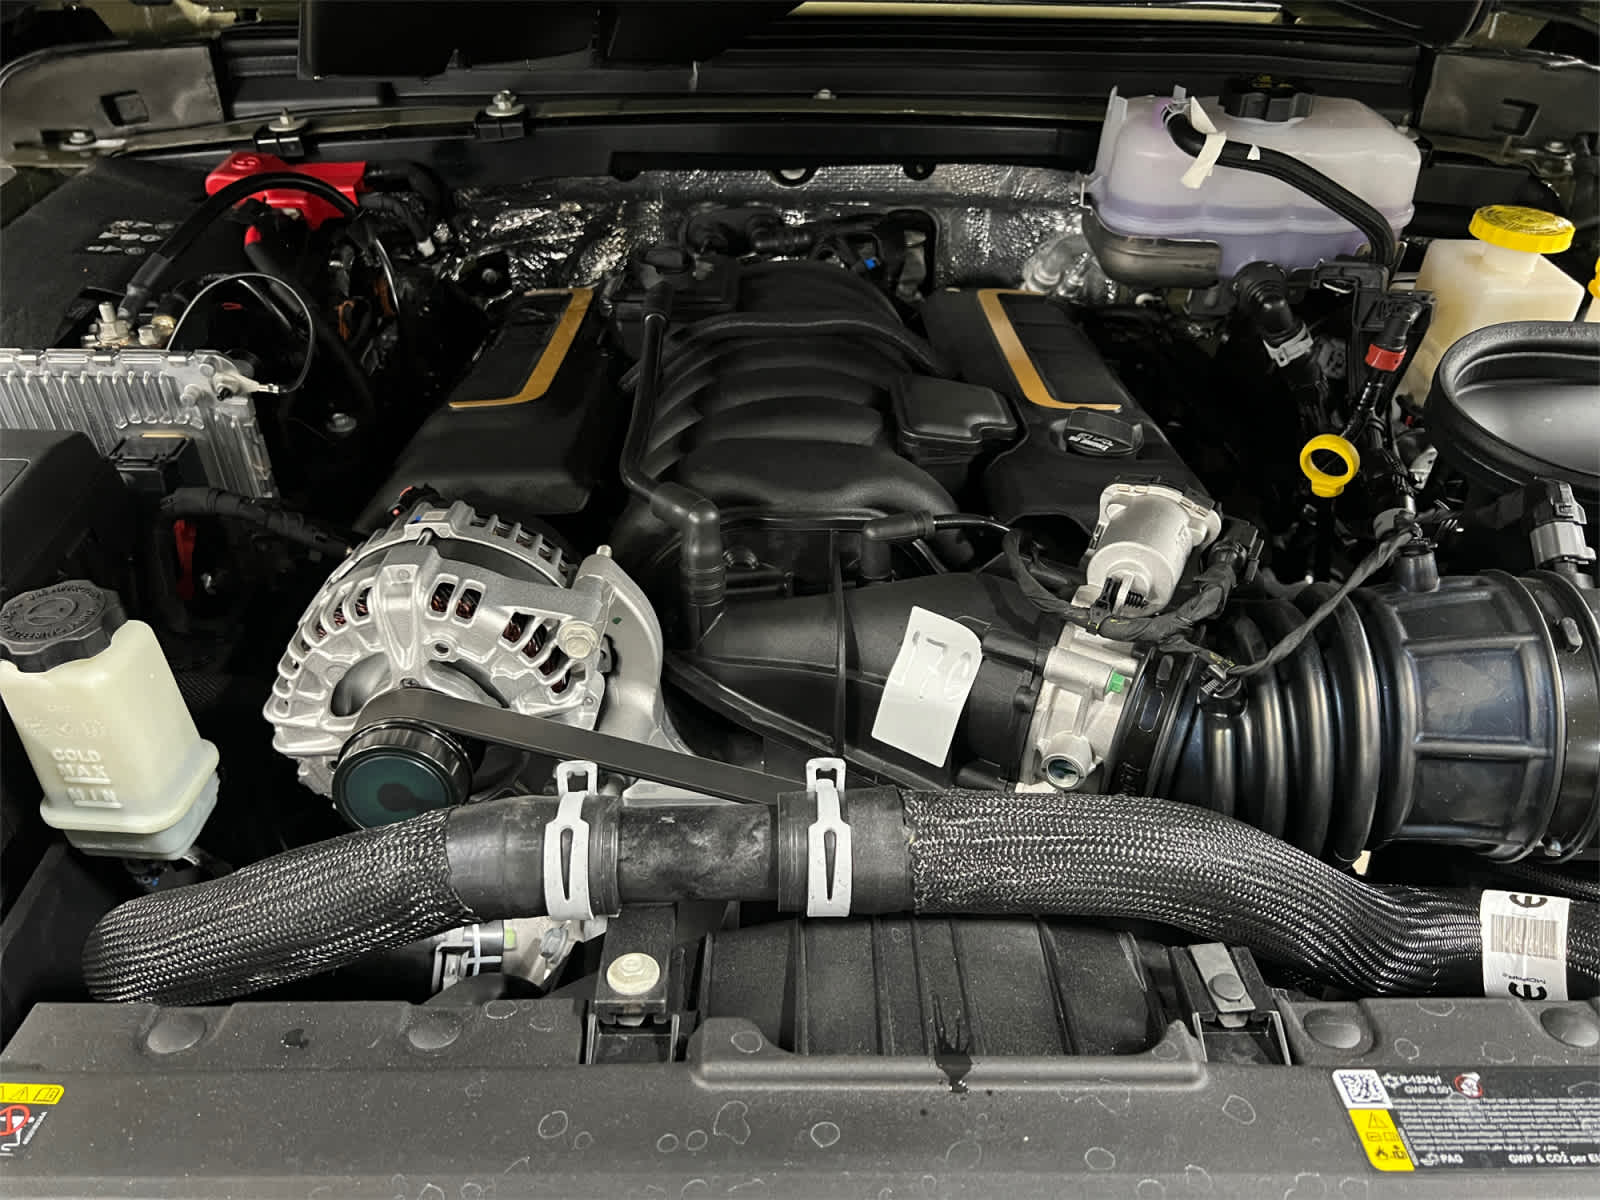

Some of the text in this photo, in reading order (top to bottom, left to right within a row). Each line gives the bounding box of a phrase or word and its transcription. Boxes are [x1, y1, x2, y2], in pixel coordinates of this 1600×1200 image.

[51, 747, 102, 762] COLD
[56, 763, 108, 778] MAX
[66, 787, 118, 801] MIN
